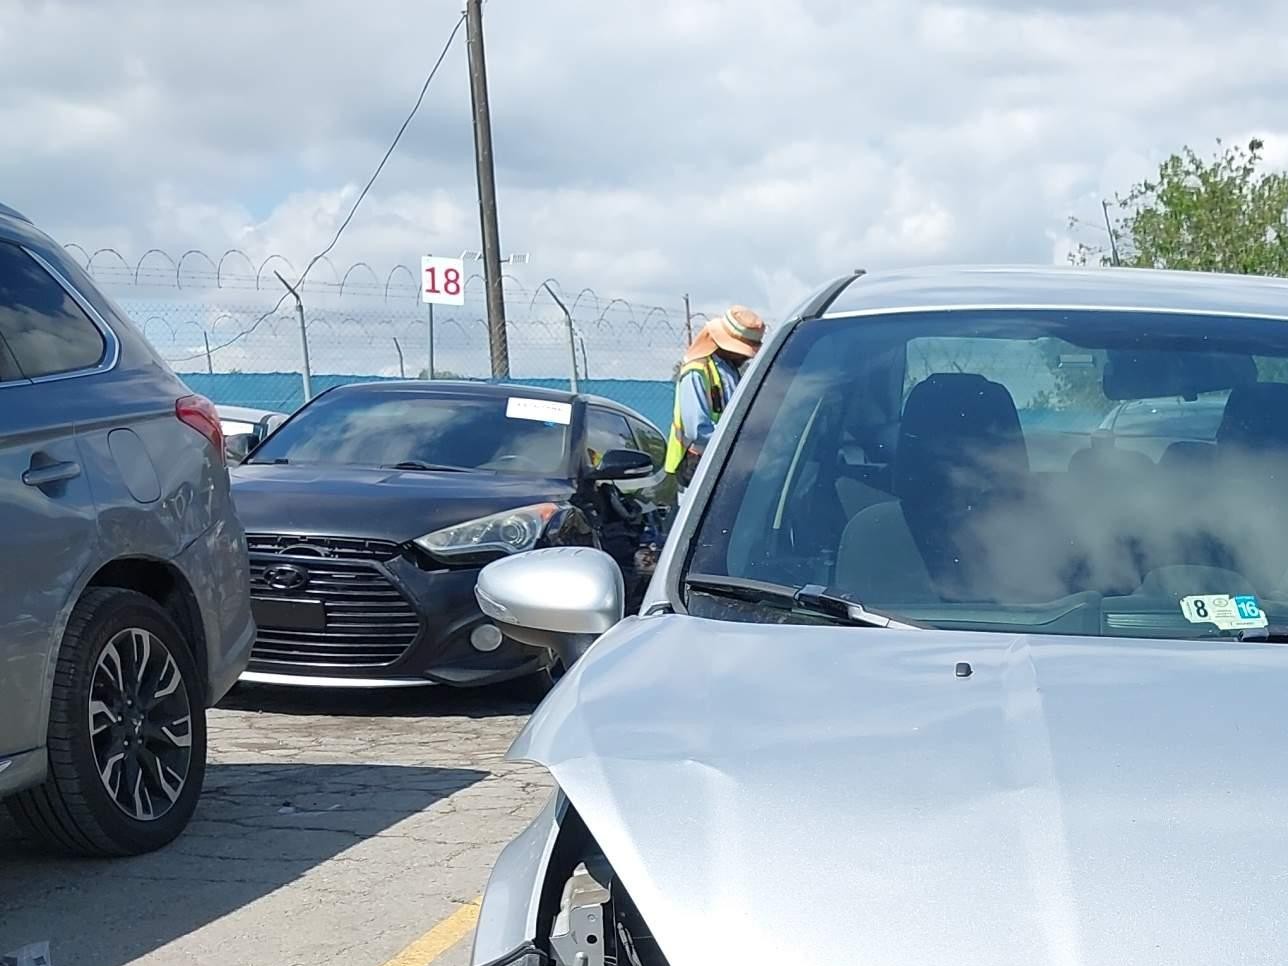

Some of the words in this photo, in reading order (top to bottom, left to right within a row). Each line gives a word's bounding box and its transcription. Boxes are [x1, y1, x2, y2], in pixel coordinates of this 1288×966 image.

[425, 267, 460, 295] 18
[1193, 599, 1208, 618] 8
[1238, 601, 1259, 617] 16
